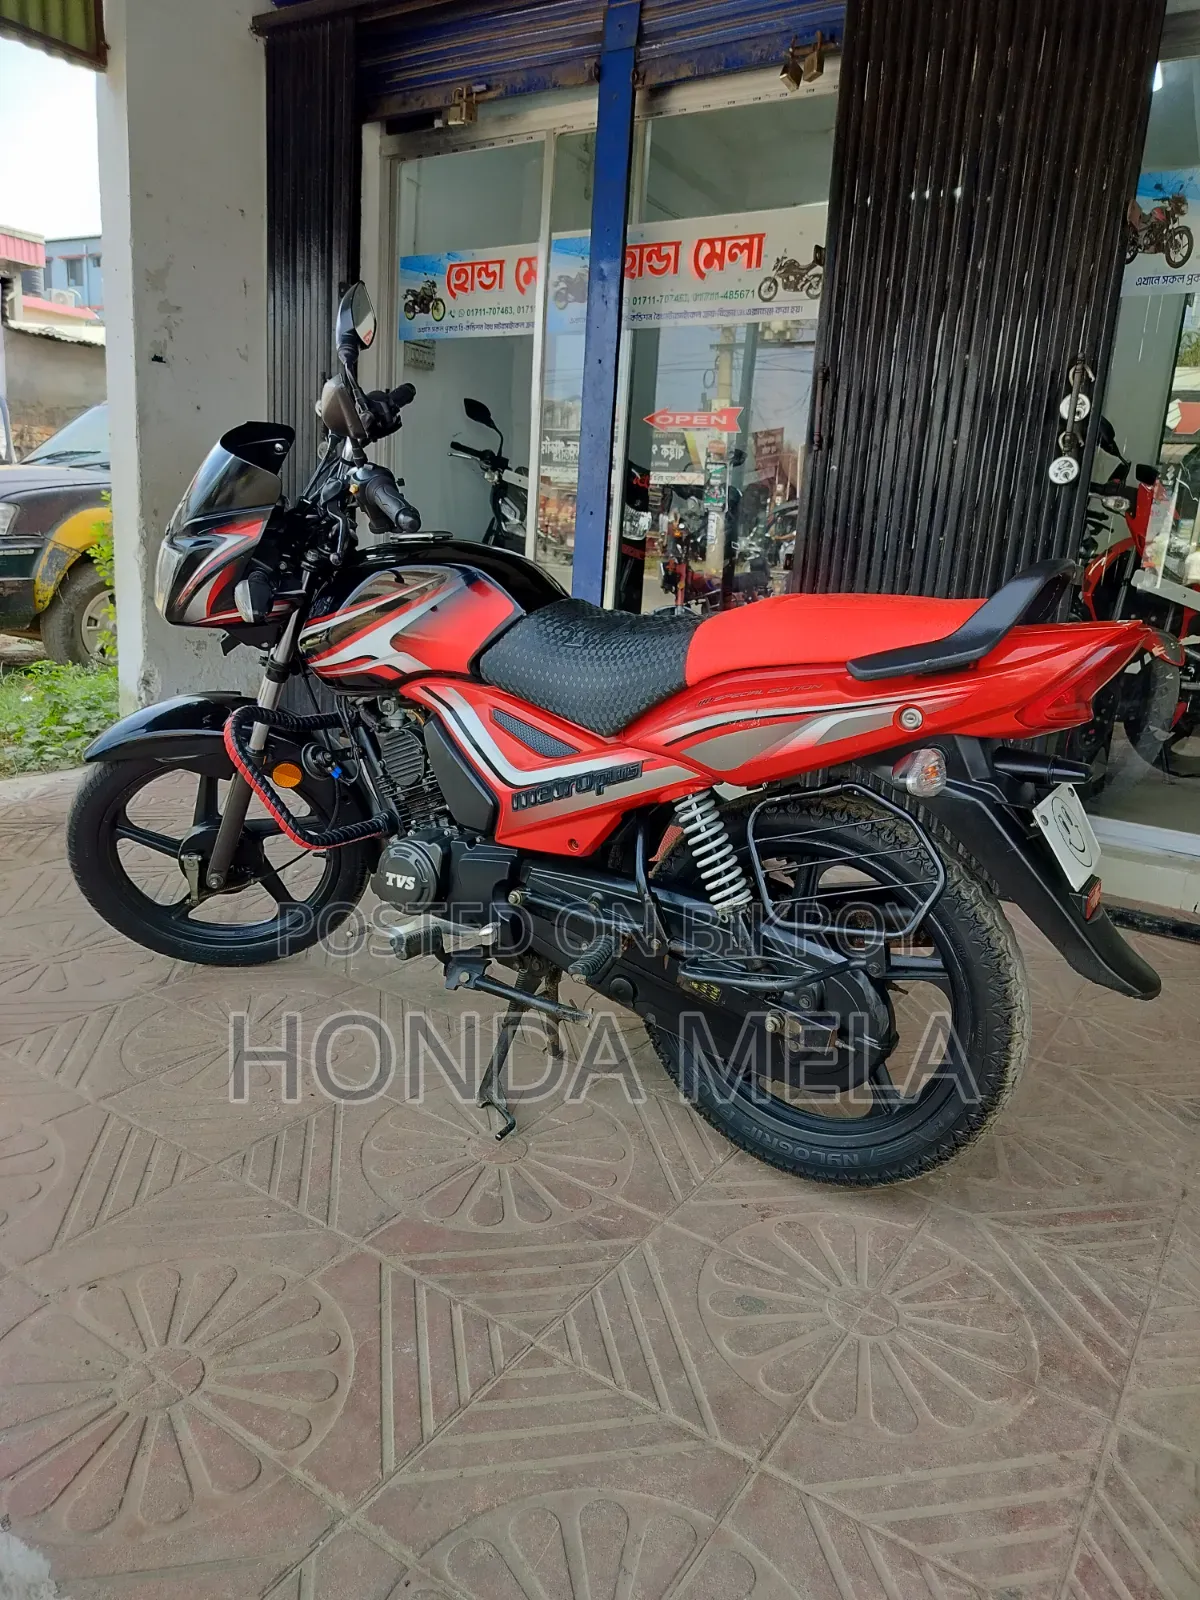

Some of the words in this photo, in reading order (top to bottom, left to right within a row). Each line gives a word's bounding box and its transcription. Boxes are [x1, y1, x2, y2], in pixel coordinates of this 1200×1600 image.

[693, 233, 767, 281] মেলা
[446, 259, 505, 300] হোন্ডা
[1135, 275, 1161, 286] এখানে
[1162, 274, 1185, 285] সকল
[466, 306, 515, 317] 01711-707463,
[655, 415, 727, 425] OPEN
[767, 683, 824, 694] EDITION
[385, 871, 416, 891] TVS
